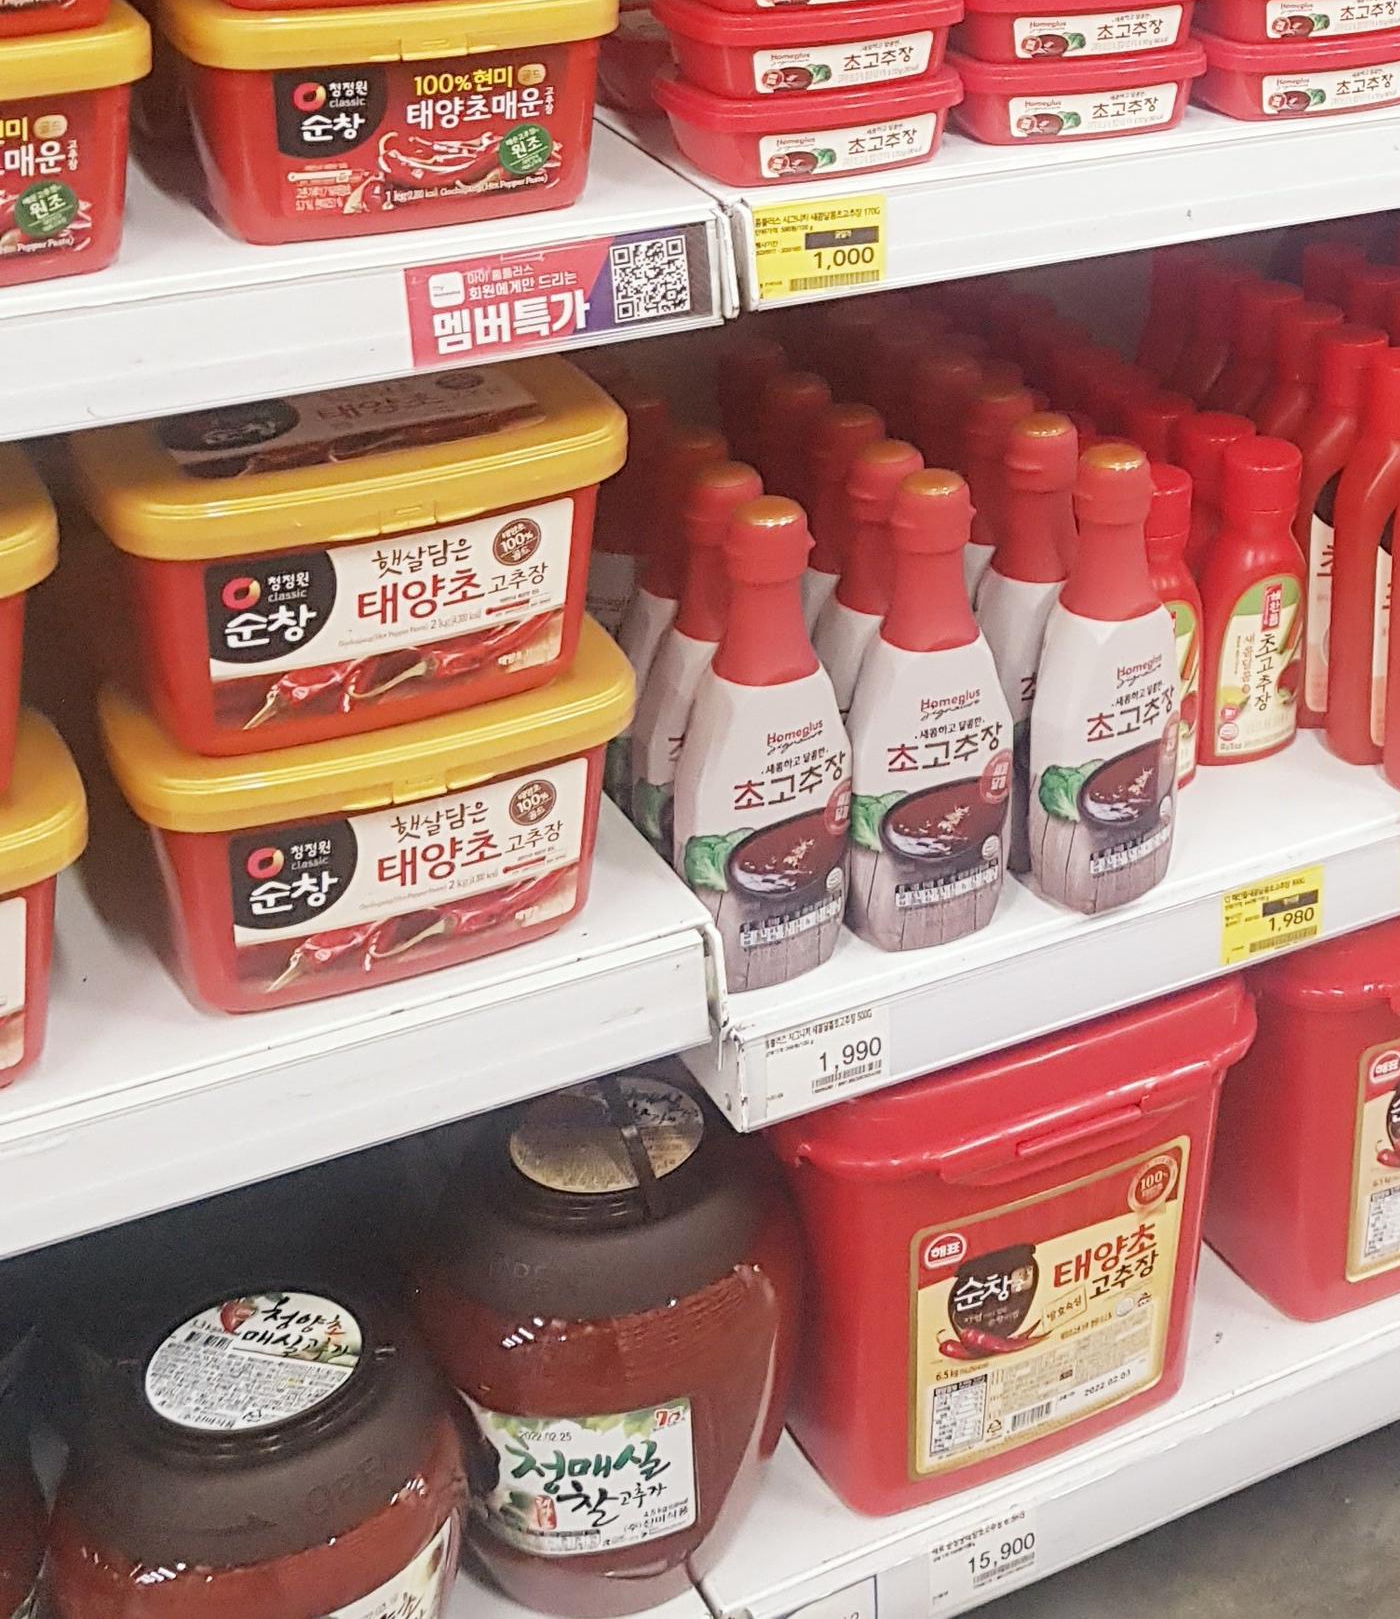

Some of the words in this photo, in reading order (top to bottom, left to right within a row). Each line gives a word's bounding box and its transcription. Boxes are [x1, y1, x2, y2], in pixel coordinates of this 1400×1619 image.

[328, 80, 368, 97] 청정원
[329, 96, 367, 108] classic
[406, 88, 544, 130] 태양초매운
[301, 112, 366, 142] 순창
[814, 246, 874, 270] 1,000
[468, 278, 536, 302] 회원에게만
[538, 271, 578, 290] 드리는
[432, 289, 591, 355] 멤버특가
[371, 538, 472, 572] 햇살담은
[266, 571, 311, 590] 청정원
[267, 588, 308, 603] classic
[356, 567, 487, 625] 태양초
[486, 561, 549, 595] 고추장
[920, 688, 981, 711] Homeplus
[886, 721, 1003, 773] 초고추장
[734, 751, 846, 810] 초고추장
[389, 800, 487, 845] 햇살담은
[289, 838, 332, 858] 청정원
[290, 855, 330, 871] classic
[376, 826, 503, 888] 태양초
[505, 819, 563, 855] 고추장
[1268, 905, 1315, 933] 1,980
[819, 1037, 881, 1072] 1,990
[930, 1242, 961, 1258] 해표
[1053, 1222, 1157, 1288] 태양초
[1089, 1250, 1159, 1300] 고추장
[505, 1440, 671, 1494] 청매실
[557, 1480, 619, 1527] 찰
[968, 1532, 1035, 1574] 15,900
